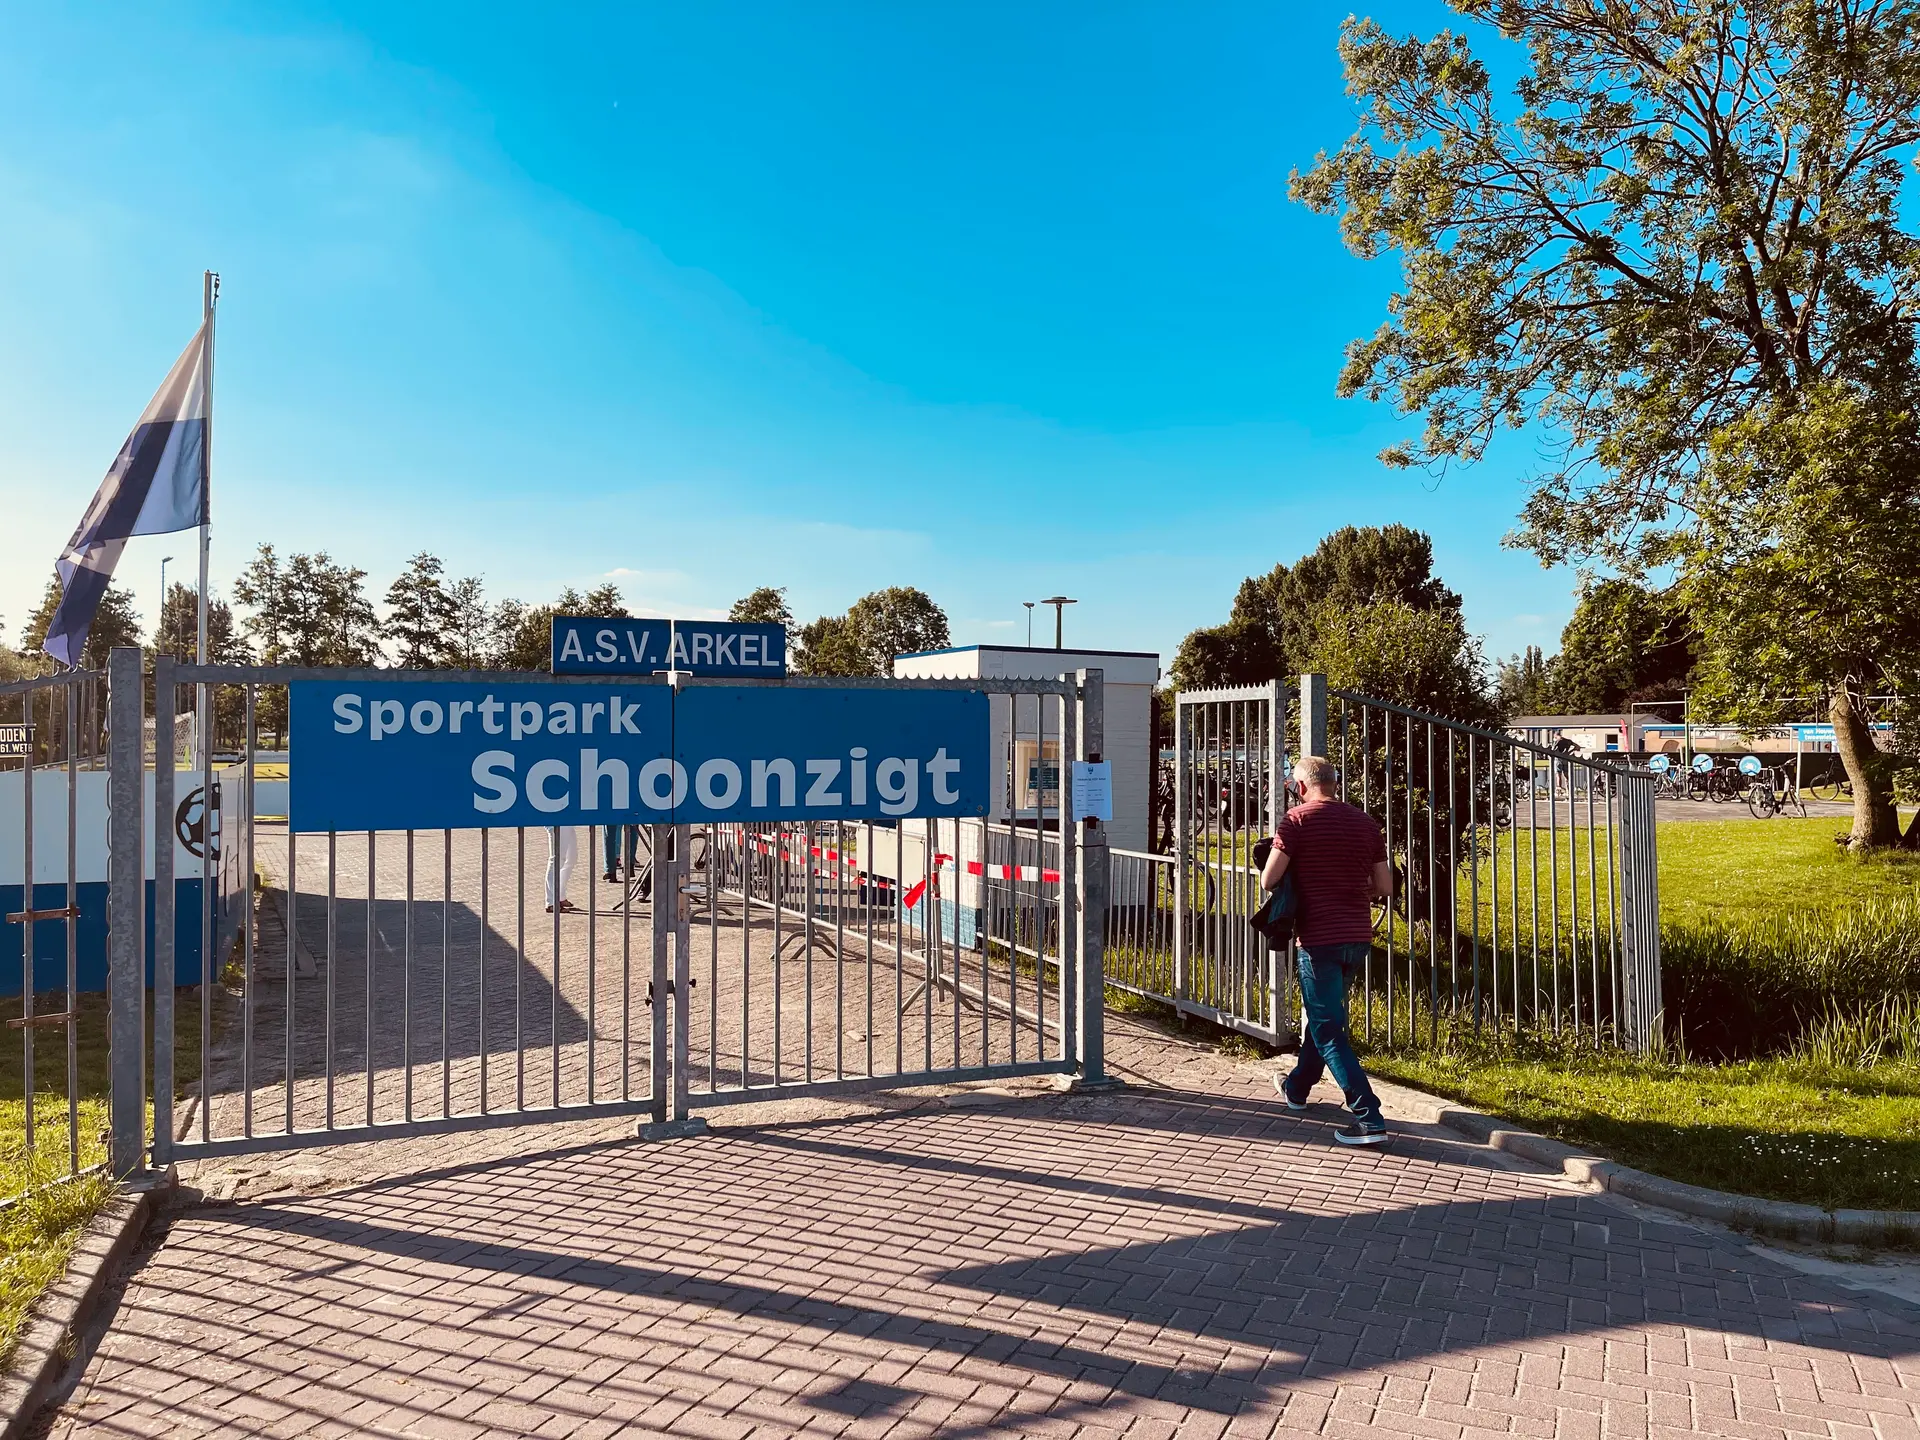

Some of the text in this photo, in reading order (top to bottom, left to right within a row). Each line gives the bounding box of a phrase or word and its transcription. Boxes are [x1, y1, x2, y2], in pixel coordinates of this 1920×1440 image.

[560, 629, 780, 667] A.S.V. ARKEL
[0, 728, 27, 742] ODEN
[332, 693, 642, 740] Sportpark
[470, 747, 961, 815] Schoonzigt
